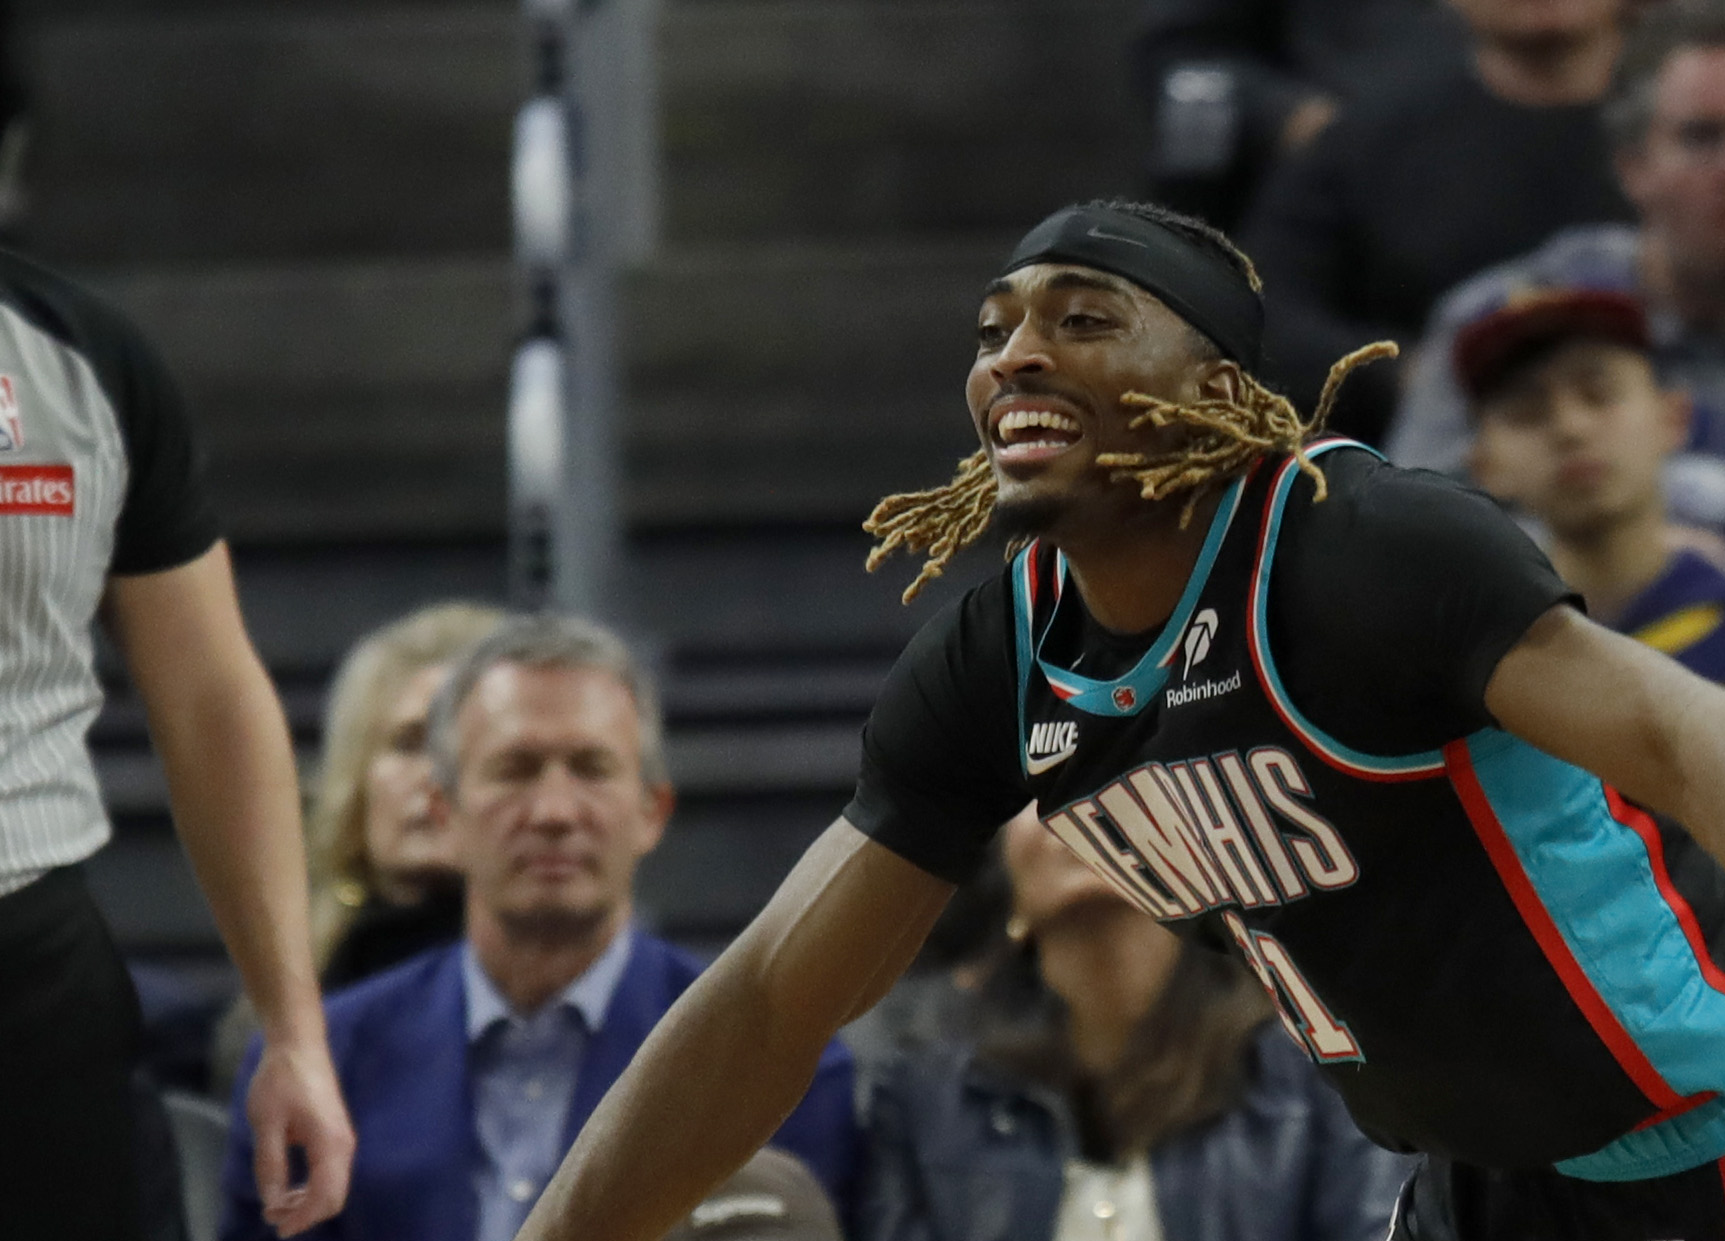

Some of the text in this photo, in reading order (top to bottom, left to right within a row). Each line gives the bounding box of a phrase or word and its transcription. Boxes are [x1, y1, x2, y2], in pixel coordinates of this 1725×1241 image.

[0, 477, 71, 504] rates
[1166, 670, 1241, 708] Robinhood
[1028, 721, 1078, 755] NIKE
[1041, 746, 1359, 922] EMHIS
